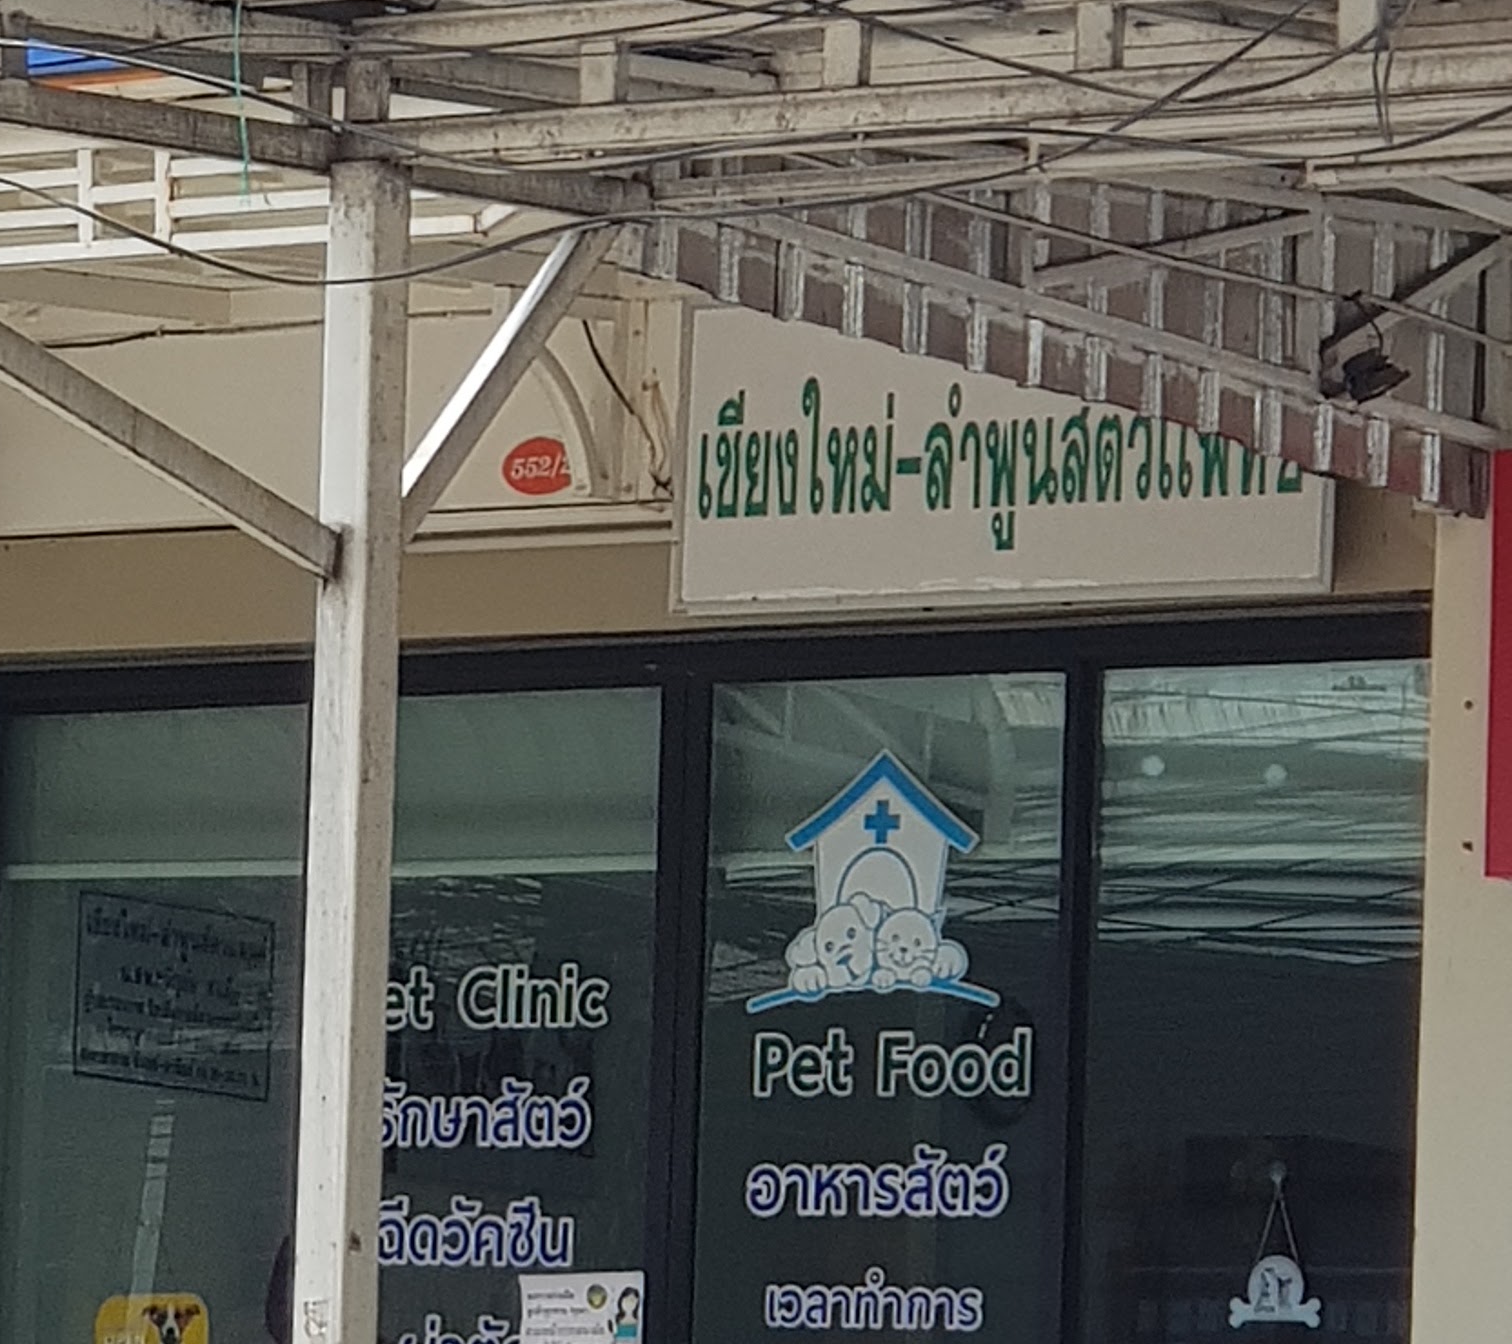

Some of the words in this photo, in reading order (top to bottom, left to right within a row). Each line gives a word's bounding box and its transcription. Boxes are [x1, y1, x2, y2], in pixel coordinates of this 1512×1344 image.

[386, 964, 435, 1032] et
[457, 962, 610, 1031] Clinic
[753, 1027, 854, 1097] Pet
[877, 1027, 1032, 1097] Food
[746, 1143, 1009, 1217] อาหารสัตว์
[378, 1194, 575, 1268] ฉีดวัคซีน
[765, 1266, 984, 1331] เวลาทำการ
